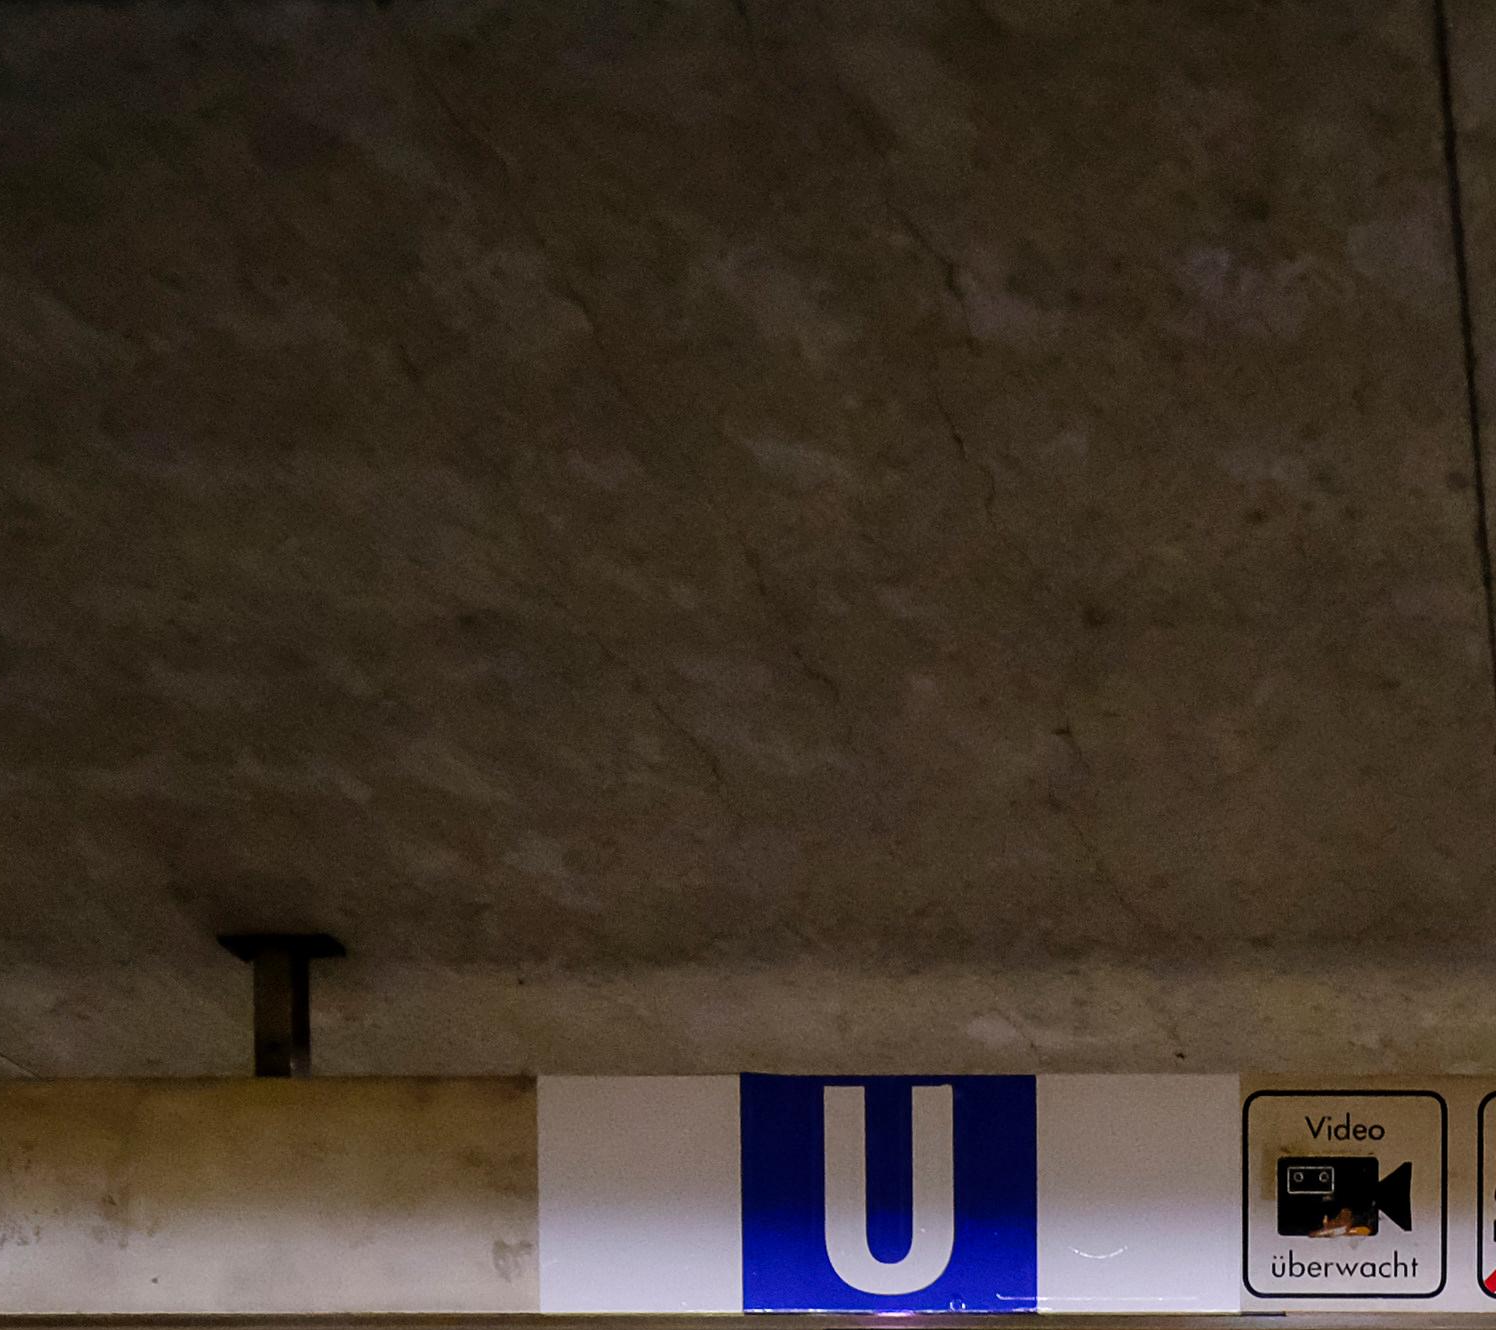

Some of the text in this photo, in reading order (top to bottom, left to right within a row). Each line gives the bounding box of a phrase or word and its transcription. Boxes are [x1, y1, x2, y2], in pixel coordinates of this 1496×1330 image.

[1305, 1112, 1386, 1141] Video
[823, 1084, 955, 1296] U
[1271, 1249, 1419, 1278] überwacht
